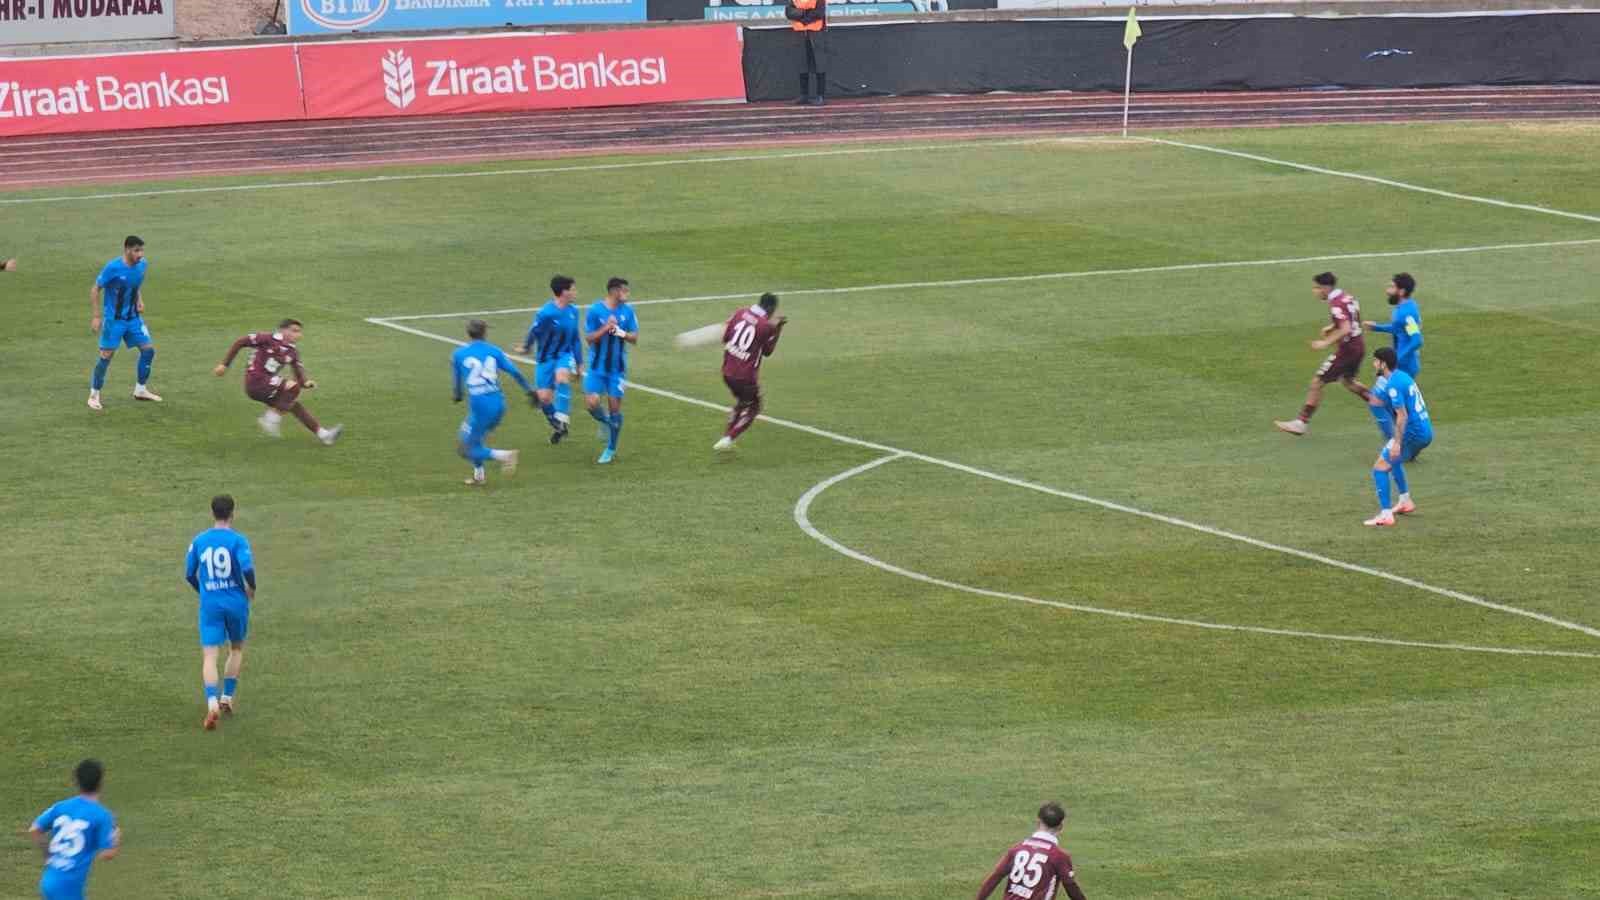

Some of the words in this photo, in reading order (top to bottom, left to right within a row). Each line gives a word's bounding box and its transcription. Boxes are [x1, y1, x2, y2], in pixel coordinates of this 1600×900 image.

[96, 72, 230, 111] Bankası
[425, 58, 528, 96] Ziraat
[533, 52, 667, 91] Bankası
[732, 320, 756, 351] 10
[463, 355, 498, 386] 24
[200, 546, 231, 580] 19
[48, 815, 90, 857] 25
[1010, 850, 1048, 887] 85
